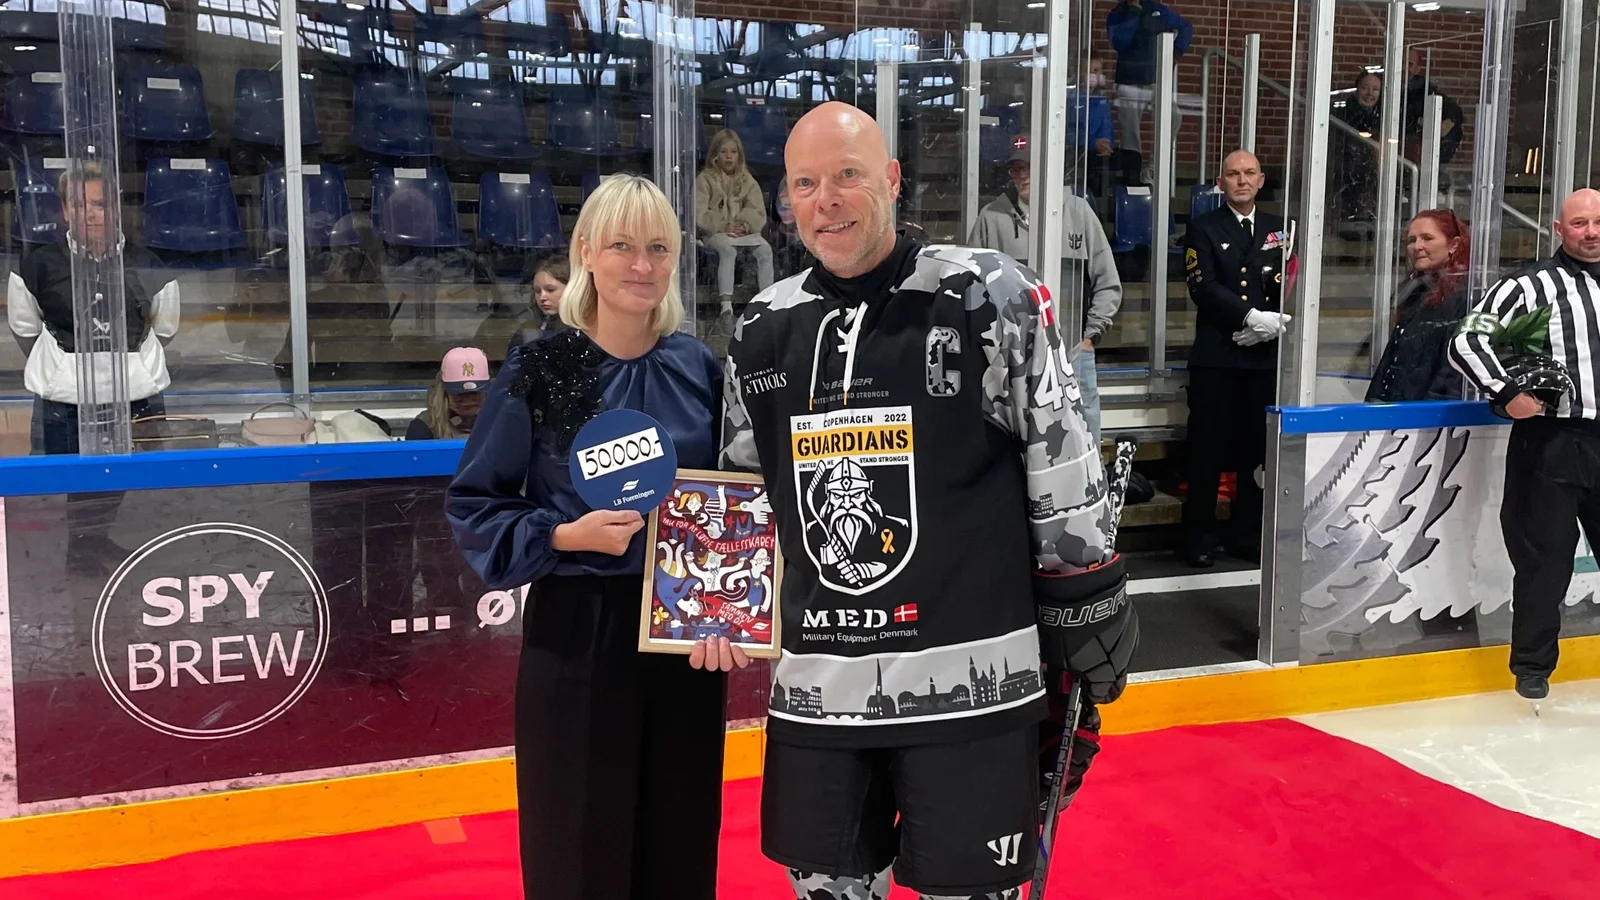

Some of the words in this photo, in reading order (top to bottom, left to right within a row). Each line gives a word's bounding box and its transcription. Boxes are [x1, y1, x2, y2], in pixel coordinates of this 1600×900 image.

[1461, 313, 1499, 333] 15
[926, 326, 961, 396] C
[856, 390, 889, 399] STRONGER
[797, 422, 813, 430] EST.
[824, 415, 873, 428] COPENHAGEN
[884, 413, 907, 422] 2022
[797, 429, 909, 457] GUARDIANS
[613, 498, 623, 506] LB
[622, 489, 655, 504] Foreningen
[142, 571, 275, 627] SPY
[477, 582, 531, 628] Ø
[1038, 586, 1126, 627] AUER
[717, 609, 734, 620] MED
[721, 602, 755, 623] SAMMEN
[802, 633, 835, 642] Military
[837, 632, 877, 644] Equipment
[879, 628, 919, 640] Denmark
[128, 630, 304, 691] BREW
